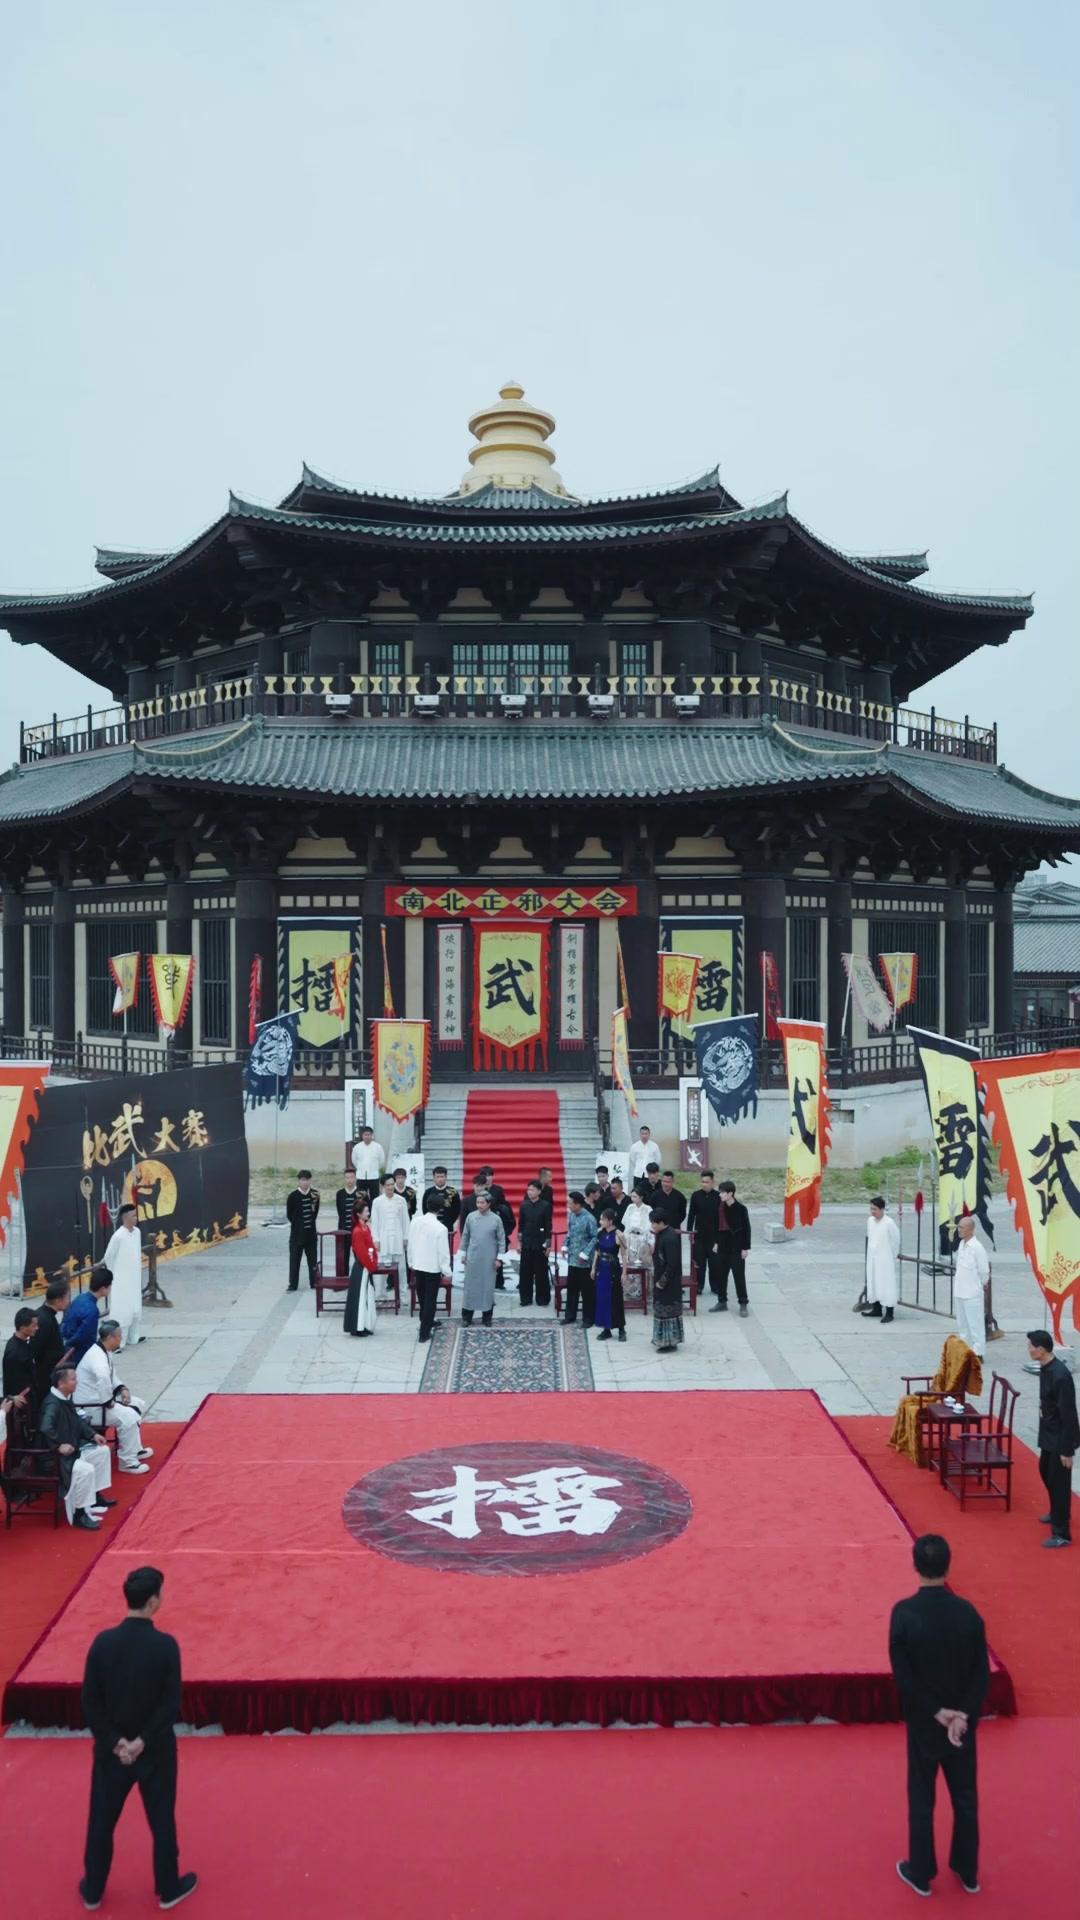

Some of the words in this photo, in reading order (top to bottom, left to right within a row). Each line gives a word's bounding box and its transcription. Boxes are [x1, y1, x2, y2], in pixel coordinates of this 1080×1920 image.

[402, 892, 621, 912] 南北正邪大会
[484, 957, 537, 1016] 武
[82, 1102, 208, 1170] 比武大赛
[405, 1465, 624, 1539] 擂
